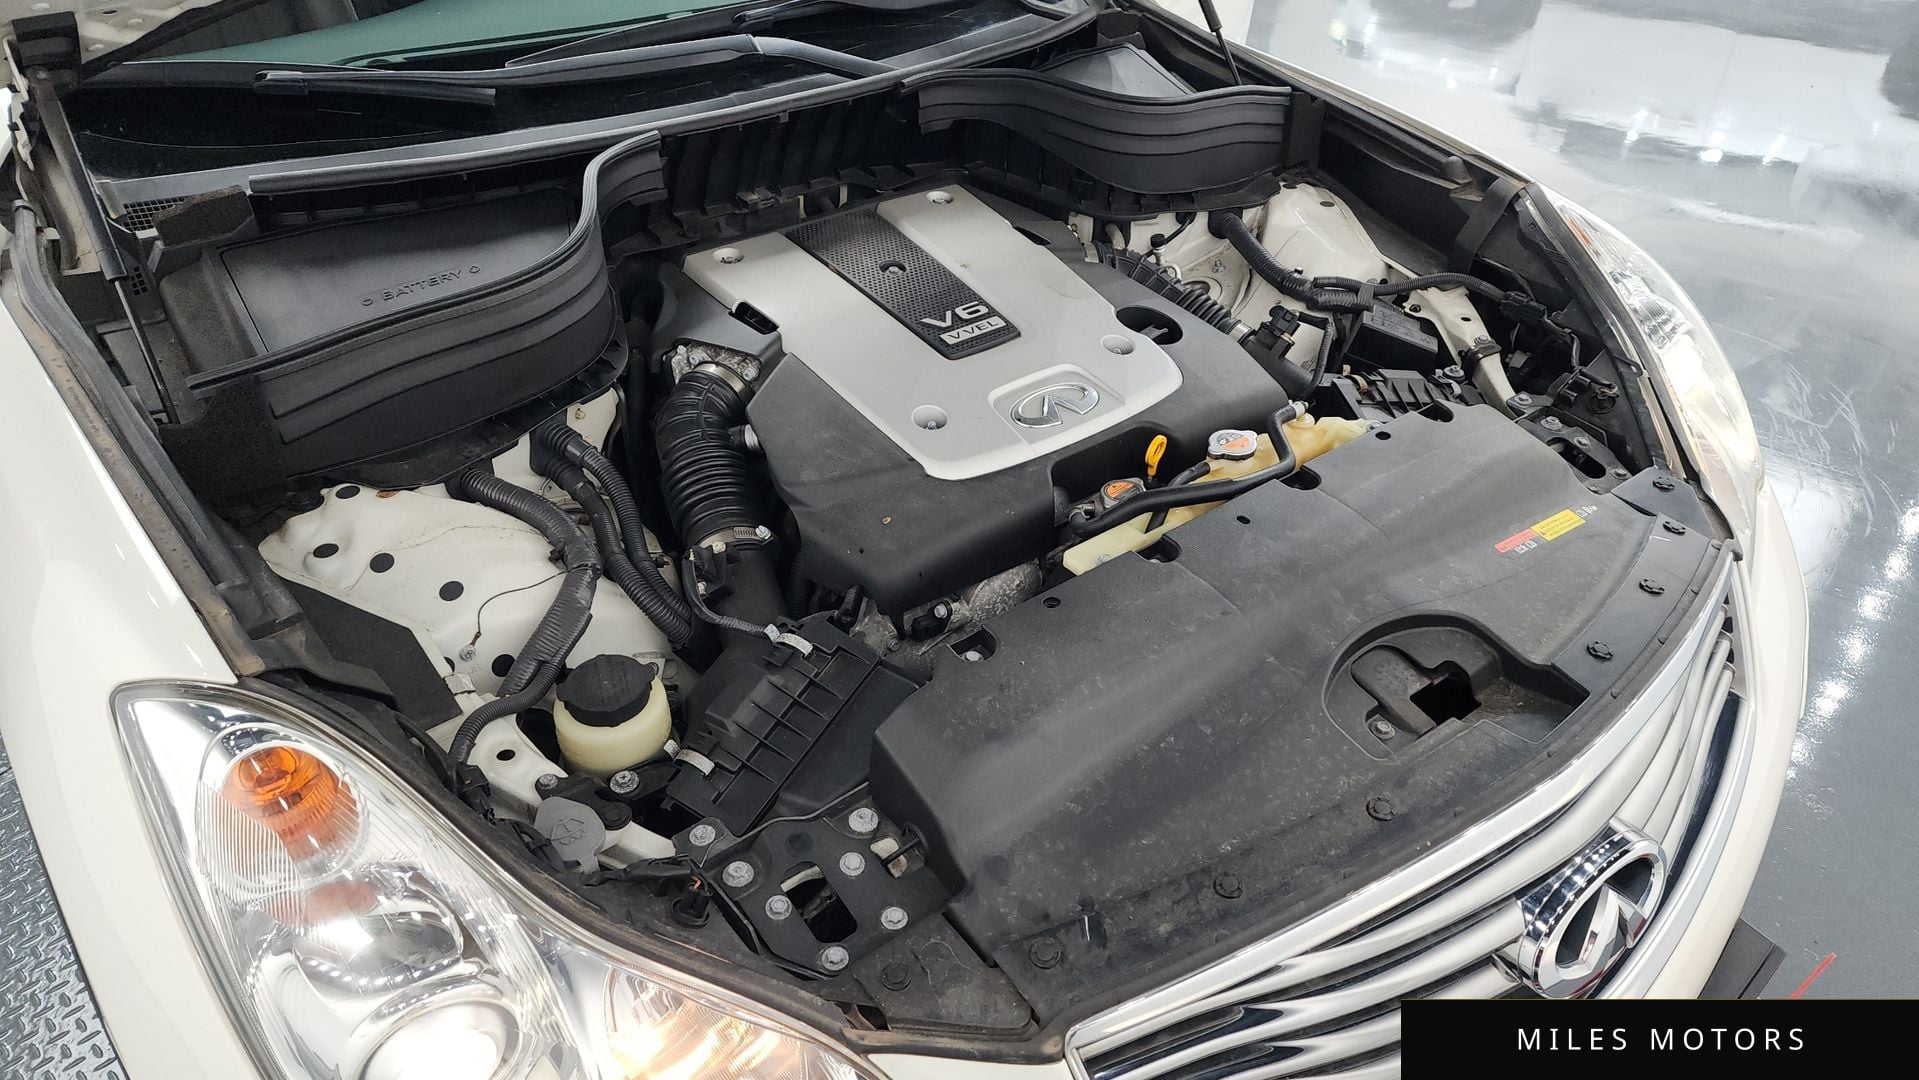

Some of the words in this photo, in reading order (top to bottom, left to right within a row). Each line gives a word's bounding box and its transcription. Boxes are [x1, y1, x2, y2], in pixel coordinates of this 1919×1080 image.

[380, 268, 463, 302] BATTERY
[920, 300, 989, 328] V6
[947, 320, 1000, 340] VVEL
